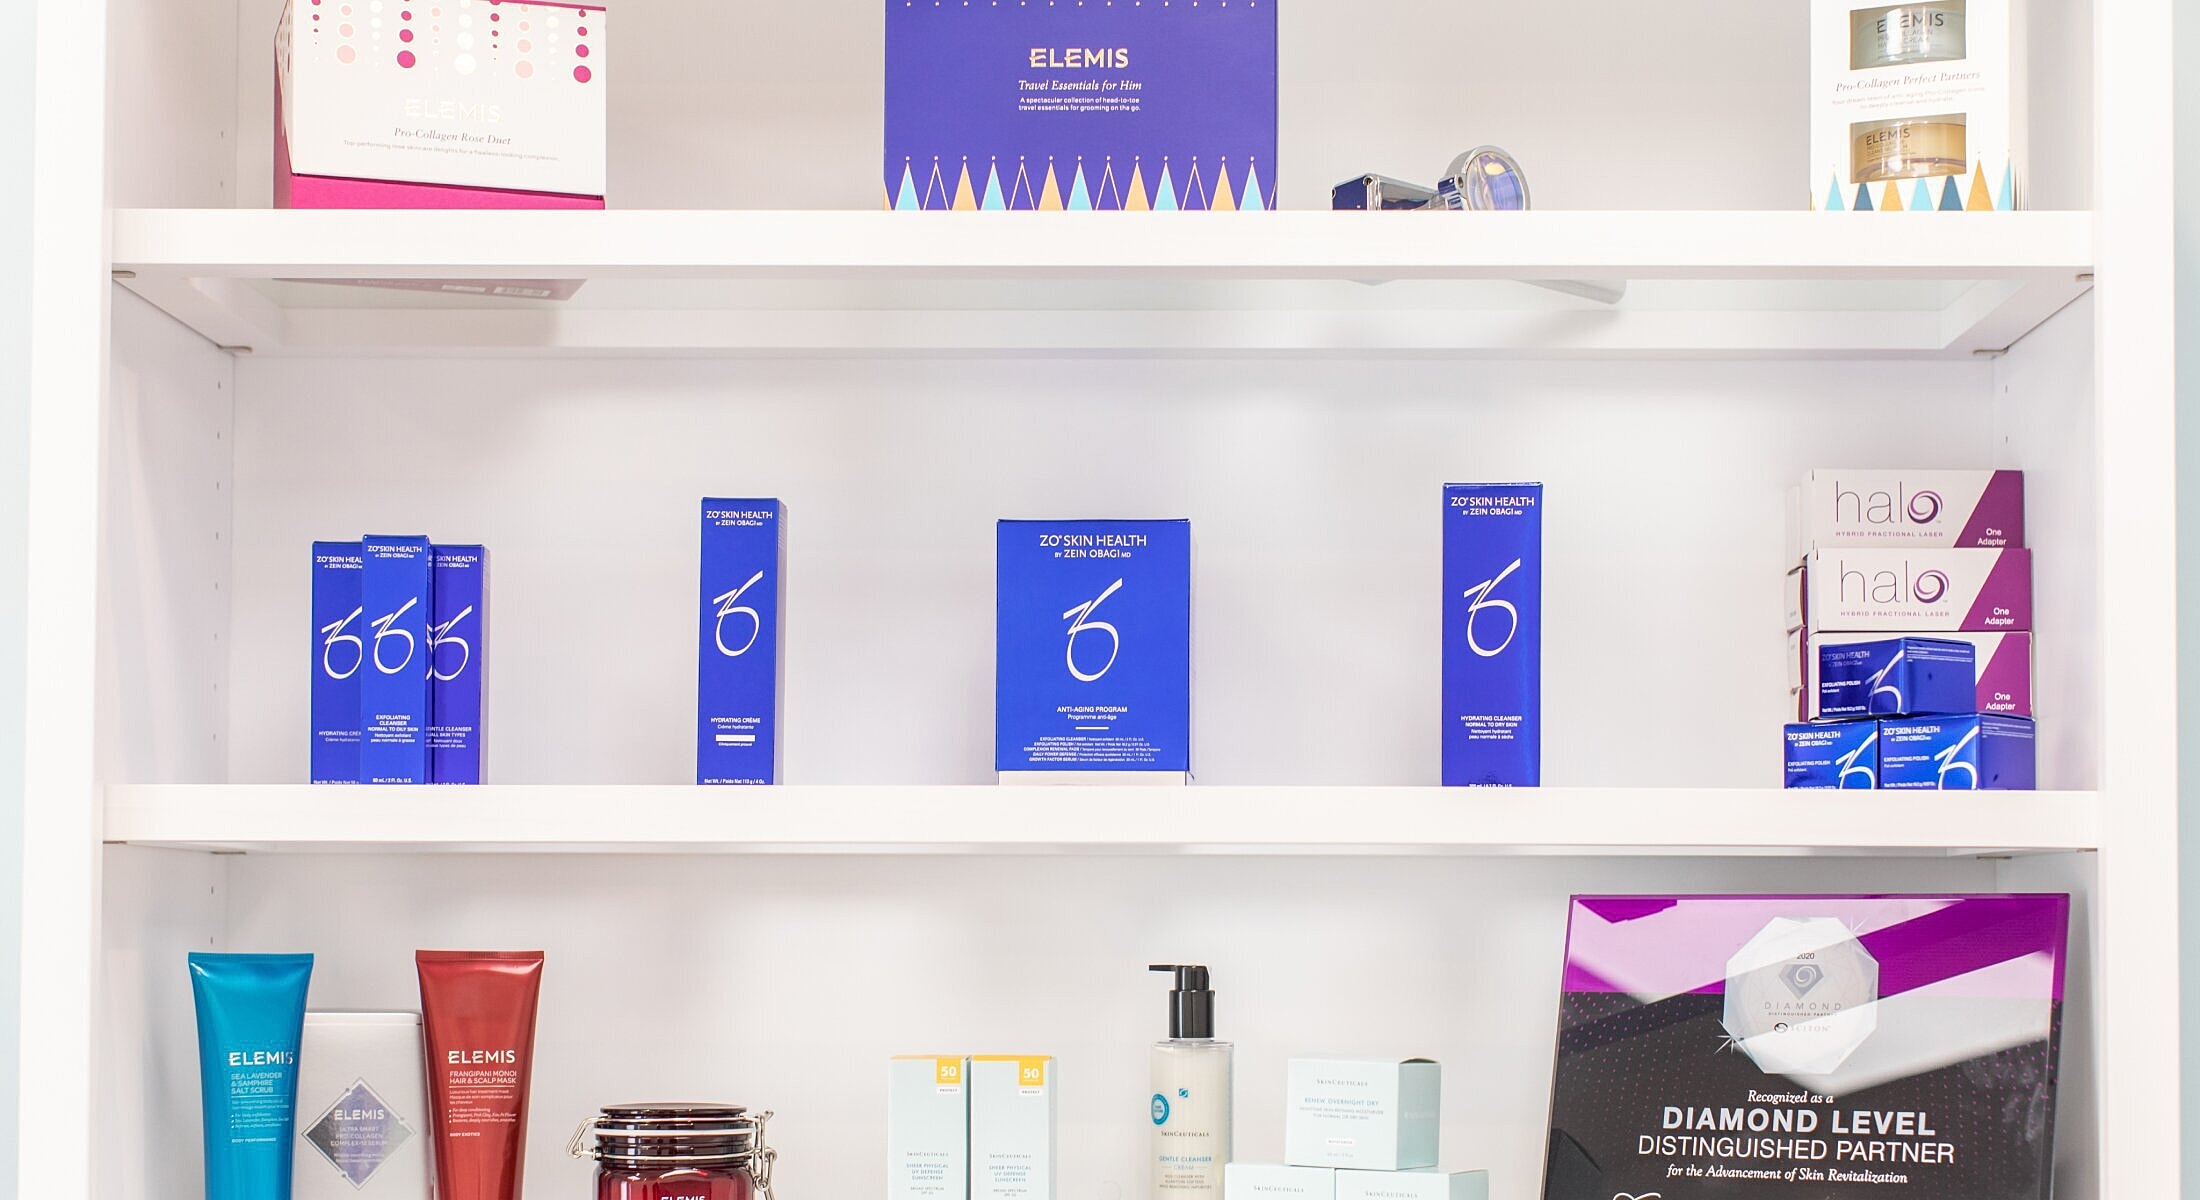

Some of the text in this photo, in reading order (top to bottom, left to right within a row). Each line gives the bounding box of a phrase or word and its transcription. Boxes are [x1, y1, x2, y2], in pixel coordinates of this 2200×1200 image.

[1876, 13, 1944, 34] EEMIS
[1029, 48, 1129, 69] ELEMIS
[1018, 79, 1142, 93] Travel Essentials for Him
[1836, 71, 1981, 92] Pro-Collagen Perfect Partners
[402, 98, 502, 123] ELEMIS
[394, 127, 512, 145] Pro-Collagen Rose Duet
[1866, 128, 1911, 146] ELEMIS
[1469, 497, 1493, 507] SKIN
[1494, 497, 1535, 507] HEALTH
[1836, 481, 1944, 525] halo
[720, 510, 741, 519] SKIN
[741, 511, 773, 519] HEALTH
[1469, 508, 1488, 516] ZEIN
[1489, 508, 1514, 516] OBAGI
[1986, 528, 2002, 536] One
[1063, 534, 1093, 547] SKIN
[1096, 534, 1147, 547] HEALTH
[1977, 537, 2007, 547] Adapter
[380, 545, 396, 553] SKIN
[396, 545, 423, 553] HEALTH
[1063, 549, 1087, 558] ZEIN
[1089, 549, 1120, 558] OBAGI
[329, 555, 345, 563] SKIN
[451, 555, 478, 563] HEALTH
[1841, 560, 1950, 604] halo
[1993, 607, 2010, 616] One
[1984, 617, 2015, 627] Adapter
[1846, 650, 1871, 660] HEALTH
[1994, 692, 2011, 701] One
[1985, 702, 2016, 713] Adapter
[1067, 713, 1097, 721] Programme
[1798, 732, 1814, 740] SKIN
[1814, 731, 1841, 739] HEALTH
[1895, 727, 1912, 735] SKIN
[1912, 726, 1940, 734] HEALTH
[1764, 1002, 1842, 1011] DIAMOND
[228, 1051, 293, 1066] ELEMIS
[448, 1050, 516, 1064] ELEMIS
[246, 1071, 282, 1080] LAVENDER
[940, 1065, 958, 1078] 50
[1023, 1067, 1041, 1080] 50
[237, 1079, 274, 1087] SAMPHIRE
[250, 1086, 274, 1094] SCRUB
[1327, 1098, 1365, 1106] OVERNIGHT
[1748, 1090, 1835, 1104] Recognized as a
[334, 1109, 385, 1121] ELEMIS
[1662, 1106, 1936, 1136] DIAMOND LEVEL
[1637, 1135, 1955, 1164] DISTINGUISHED PARTNER
[1666, 1163, 1909, 1185] for the Advancement of Skin Revitalization
